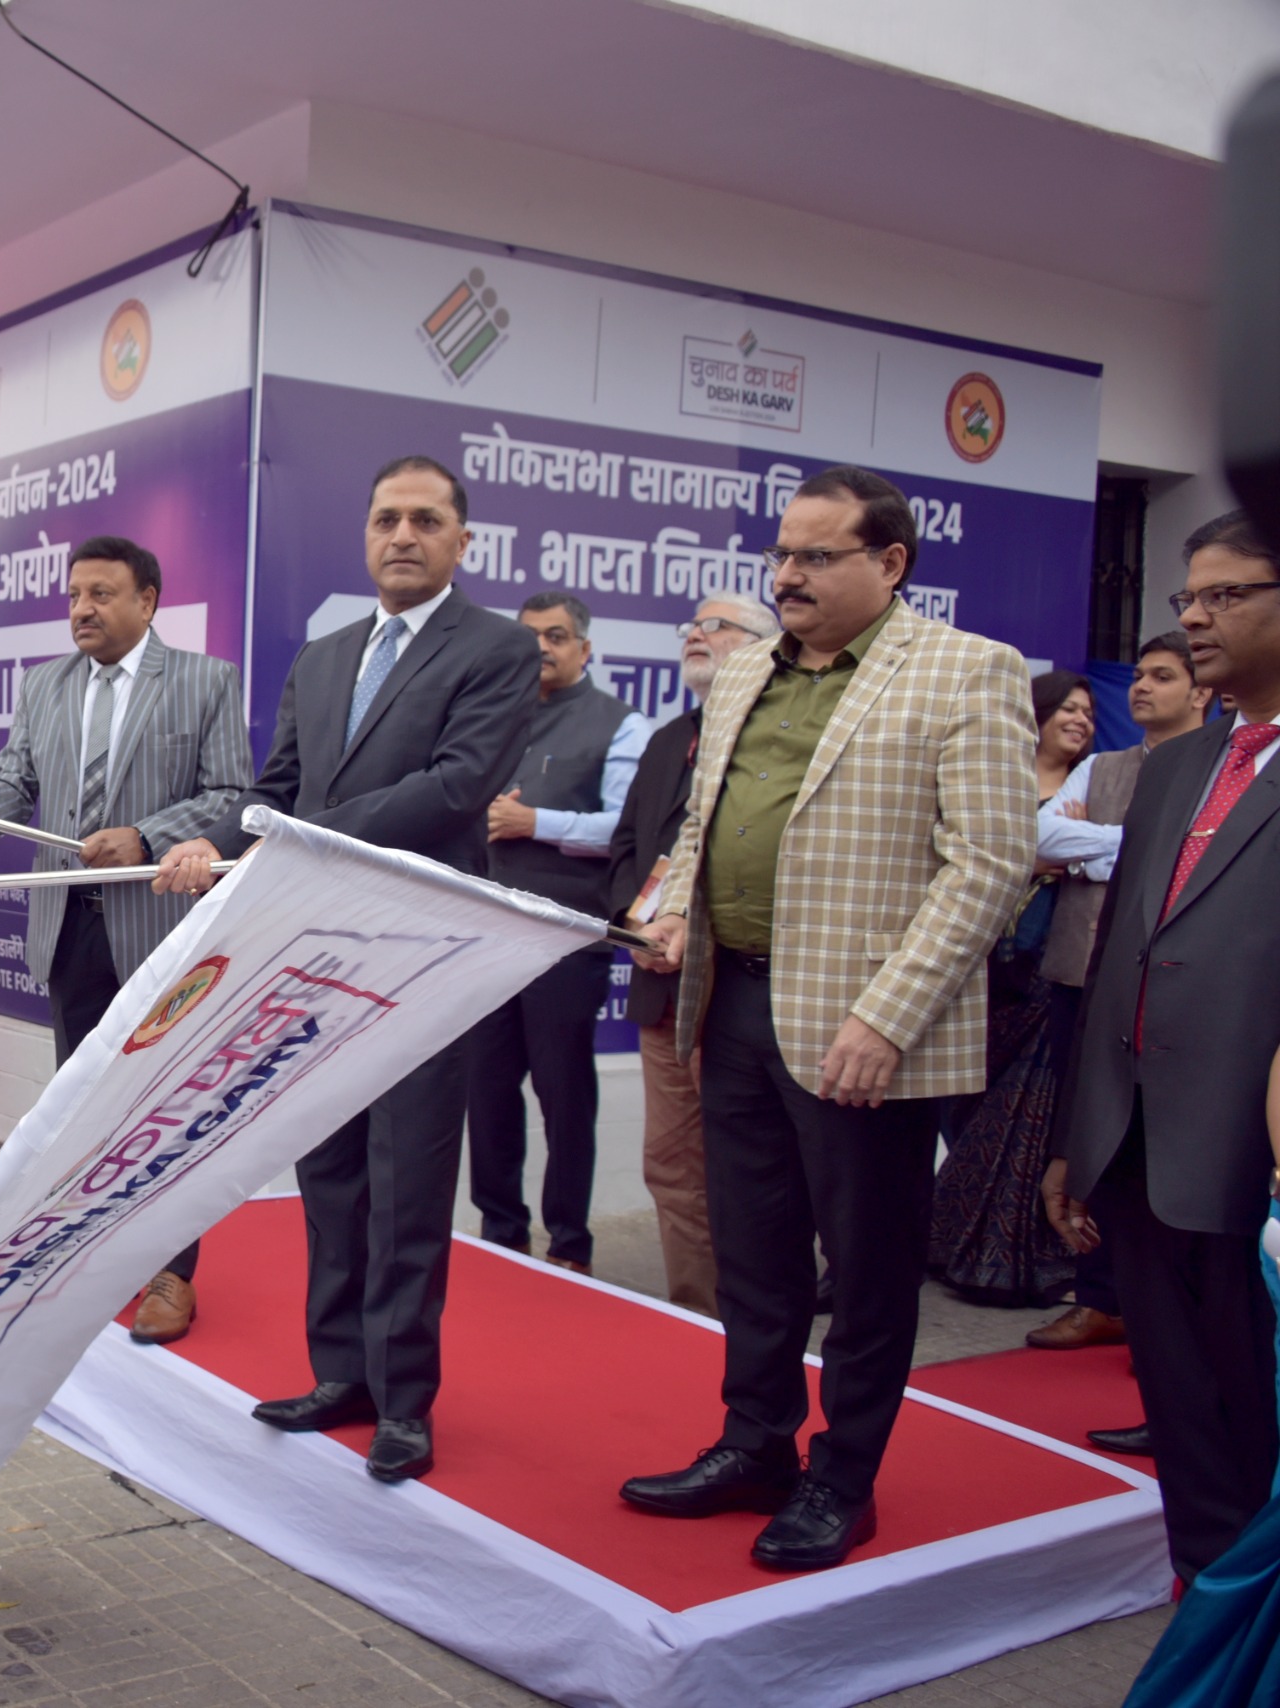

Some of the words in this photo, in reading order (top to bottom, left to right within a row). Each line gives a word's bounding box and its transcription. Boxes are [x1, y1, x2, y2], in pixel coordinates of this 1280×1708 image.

[689, 355, 740, 387] चुनाव
[743, 364, 768, 389] का
[771, 364, 799, 394] पर्व
[707, 384, 739, 402] DESH
[742, 389, 758, 407] KA
[760, 393, 794, 413] GARV
[460, 421, 624, 499] लोकसभा
[627, 456, 762, 516] सामान्य
[460, 520, 526, 584] मा.
[539, 529, 648, 595] भारत
[116, 1149, 186, 1202] KA
[192, 1017, 320, 1141] GARV
[81, 1107, 182, 1195] का
